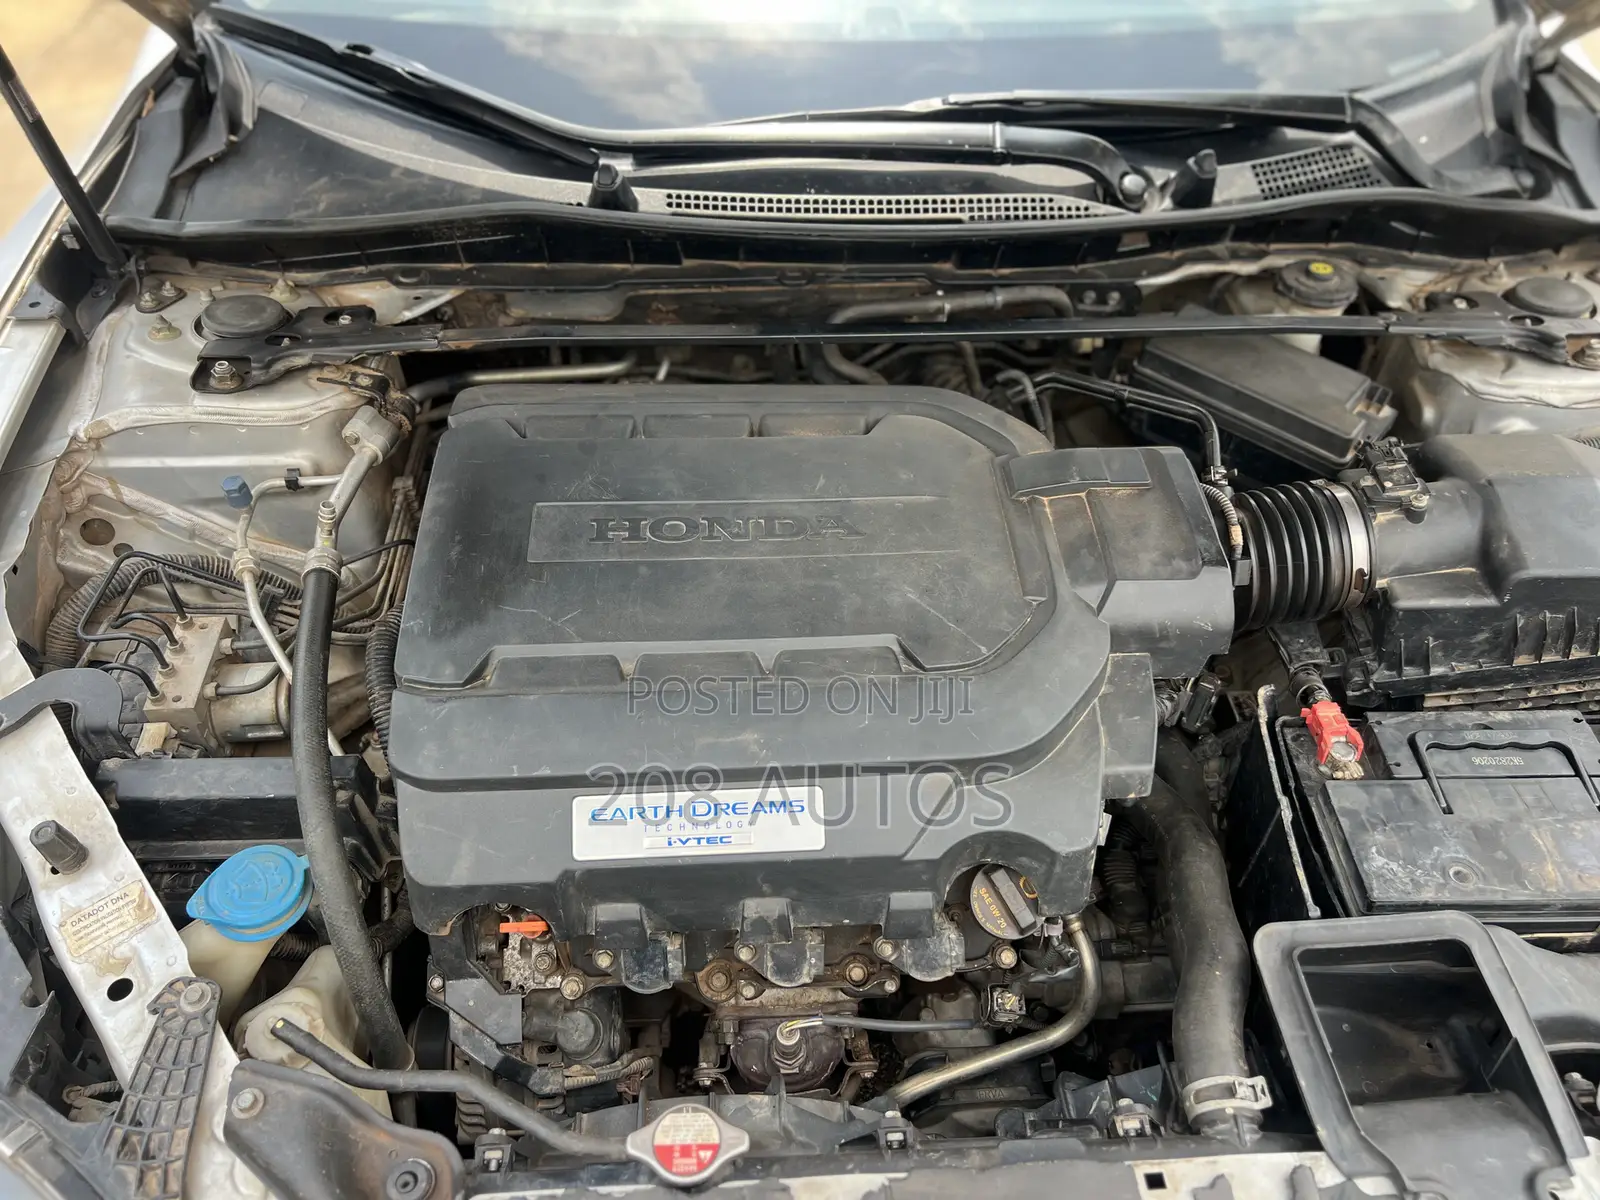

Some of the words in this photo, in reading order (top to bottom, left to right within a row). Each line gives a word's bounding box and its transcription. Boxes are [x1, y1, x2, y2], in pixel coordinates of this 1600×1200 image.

[587, 515, 867, 544] HONDA
[590, 804, 683, 823] EARTH
[691, 799, 806, 818] DREAMS
[70, 901, 110, 928] DATADOT
[110, 891, 130, 906] DNA
[979, 887, 993, 905] SAE
[989, 904, 1007, 929] 0W-20
